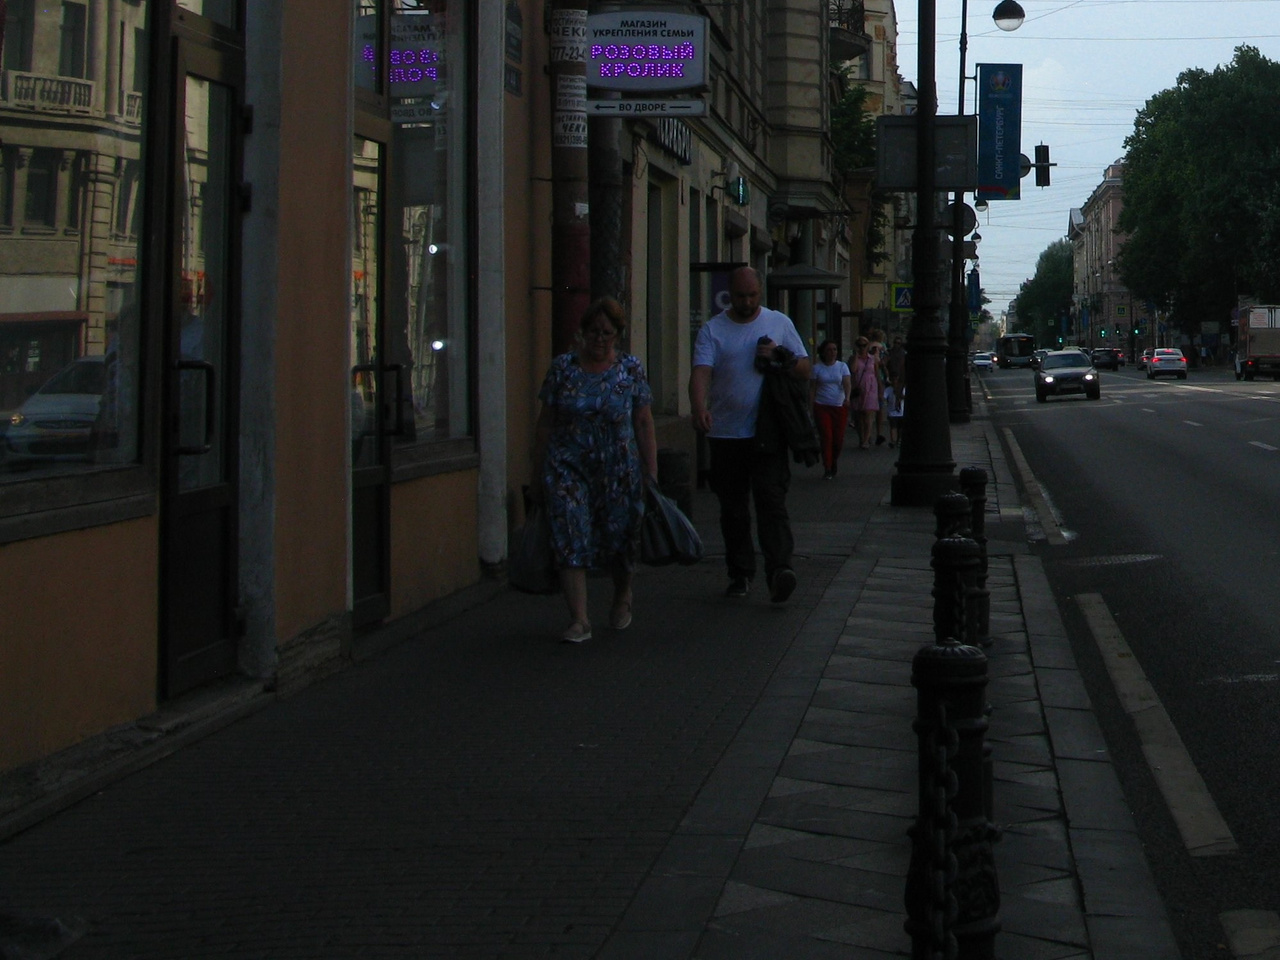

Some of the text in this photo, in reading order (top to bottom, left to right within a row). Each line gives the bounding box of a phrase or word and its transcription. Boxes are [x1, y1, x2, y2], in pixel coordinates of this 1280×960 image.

[620, 20, 667, 28] МАГАЗИН
[593, 29, 694, 38] УКРЕПЛЕНИЯ СЕМЬИ
[591, 41, 694, 59] РОЗОВЫЙ
[600, 62, 684, 77] КРОЛИК
[619, 103, 666, 113] ВО ДВОРЕ
[995, 104, 1004, 179] САНКТ-ПЕТЕРБУРГ
